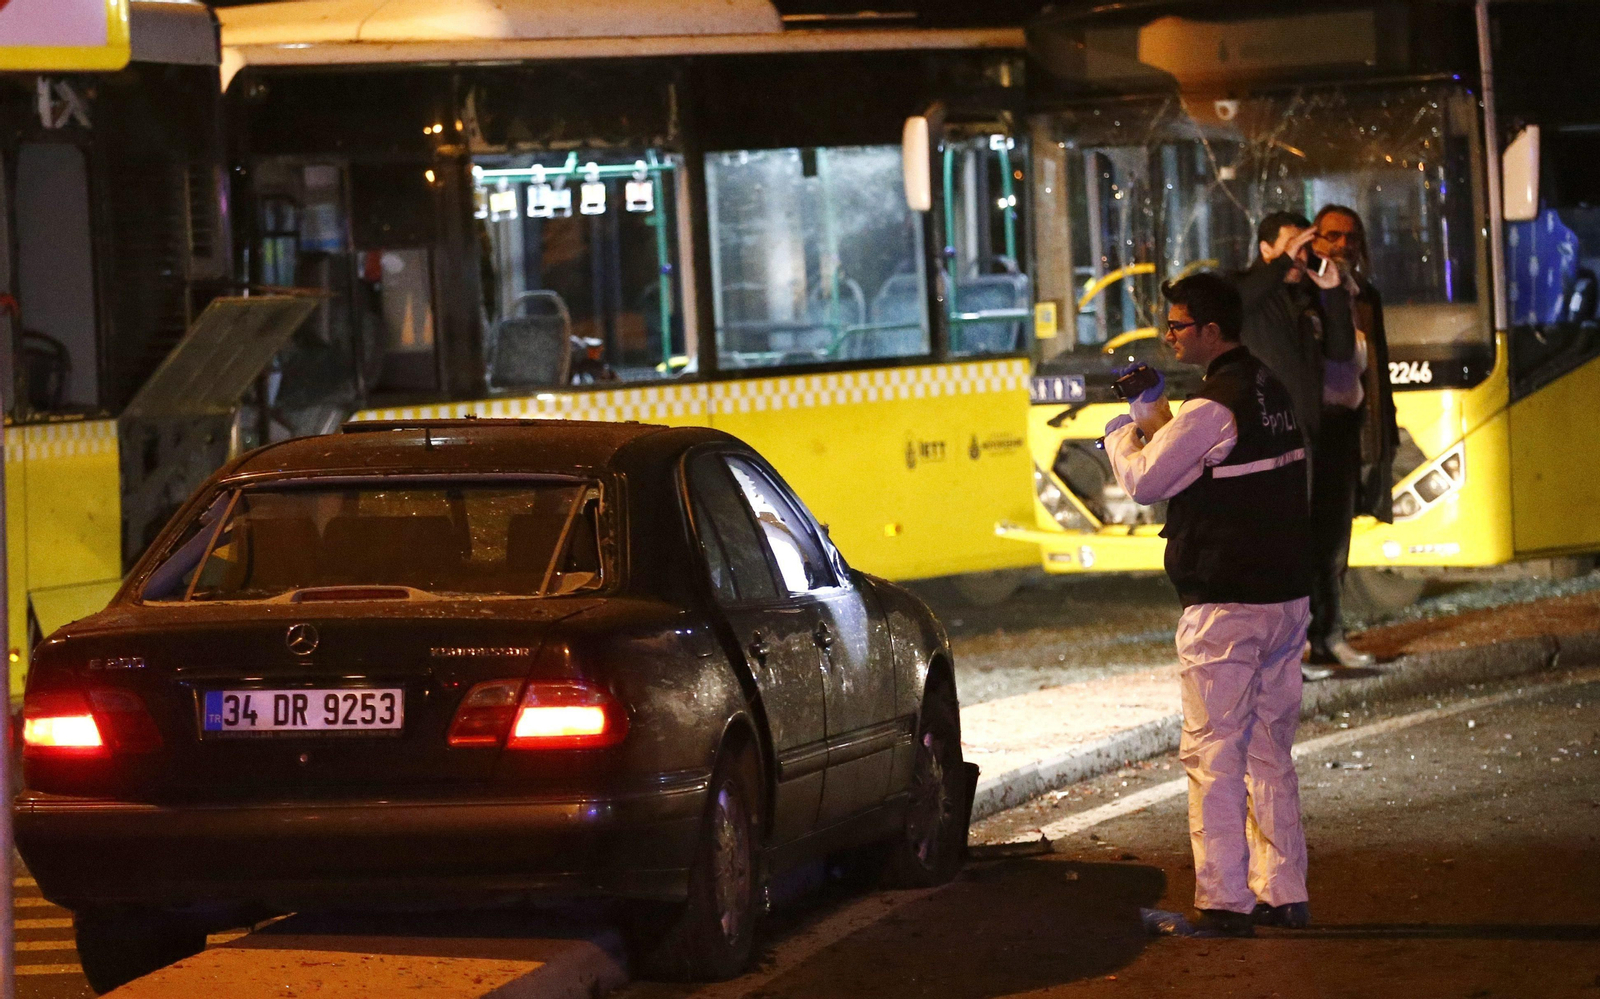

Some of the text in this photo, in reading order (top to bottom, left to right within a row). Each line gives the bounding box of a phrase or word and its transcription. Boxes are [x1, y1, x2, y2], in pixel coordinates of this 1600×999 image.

[1388, 361, 1432, 384] 2246
[208, 714, 221, 723] TR
[224, 692, 396, 726] 34 DR 9253
